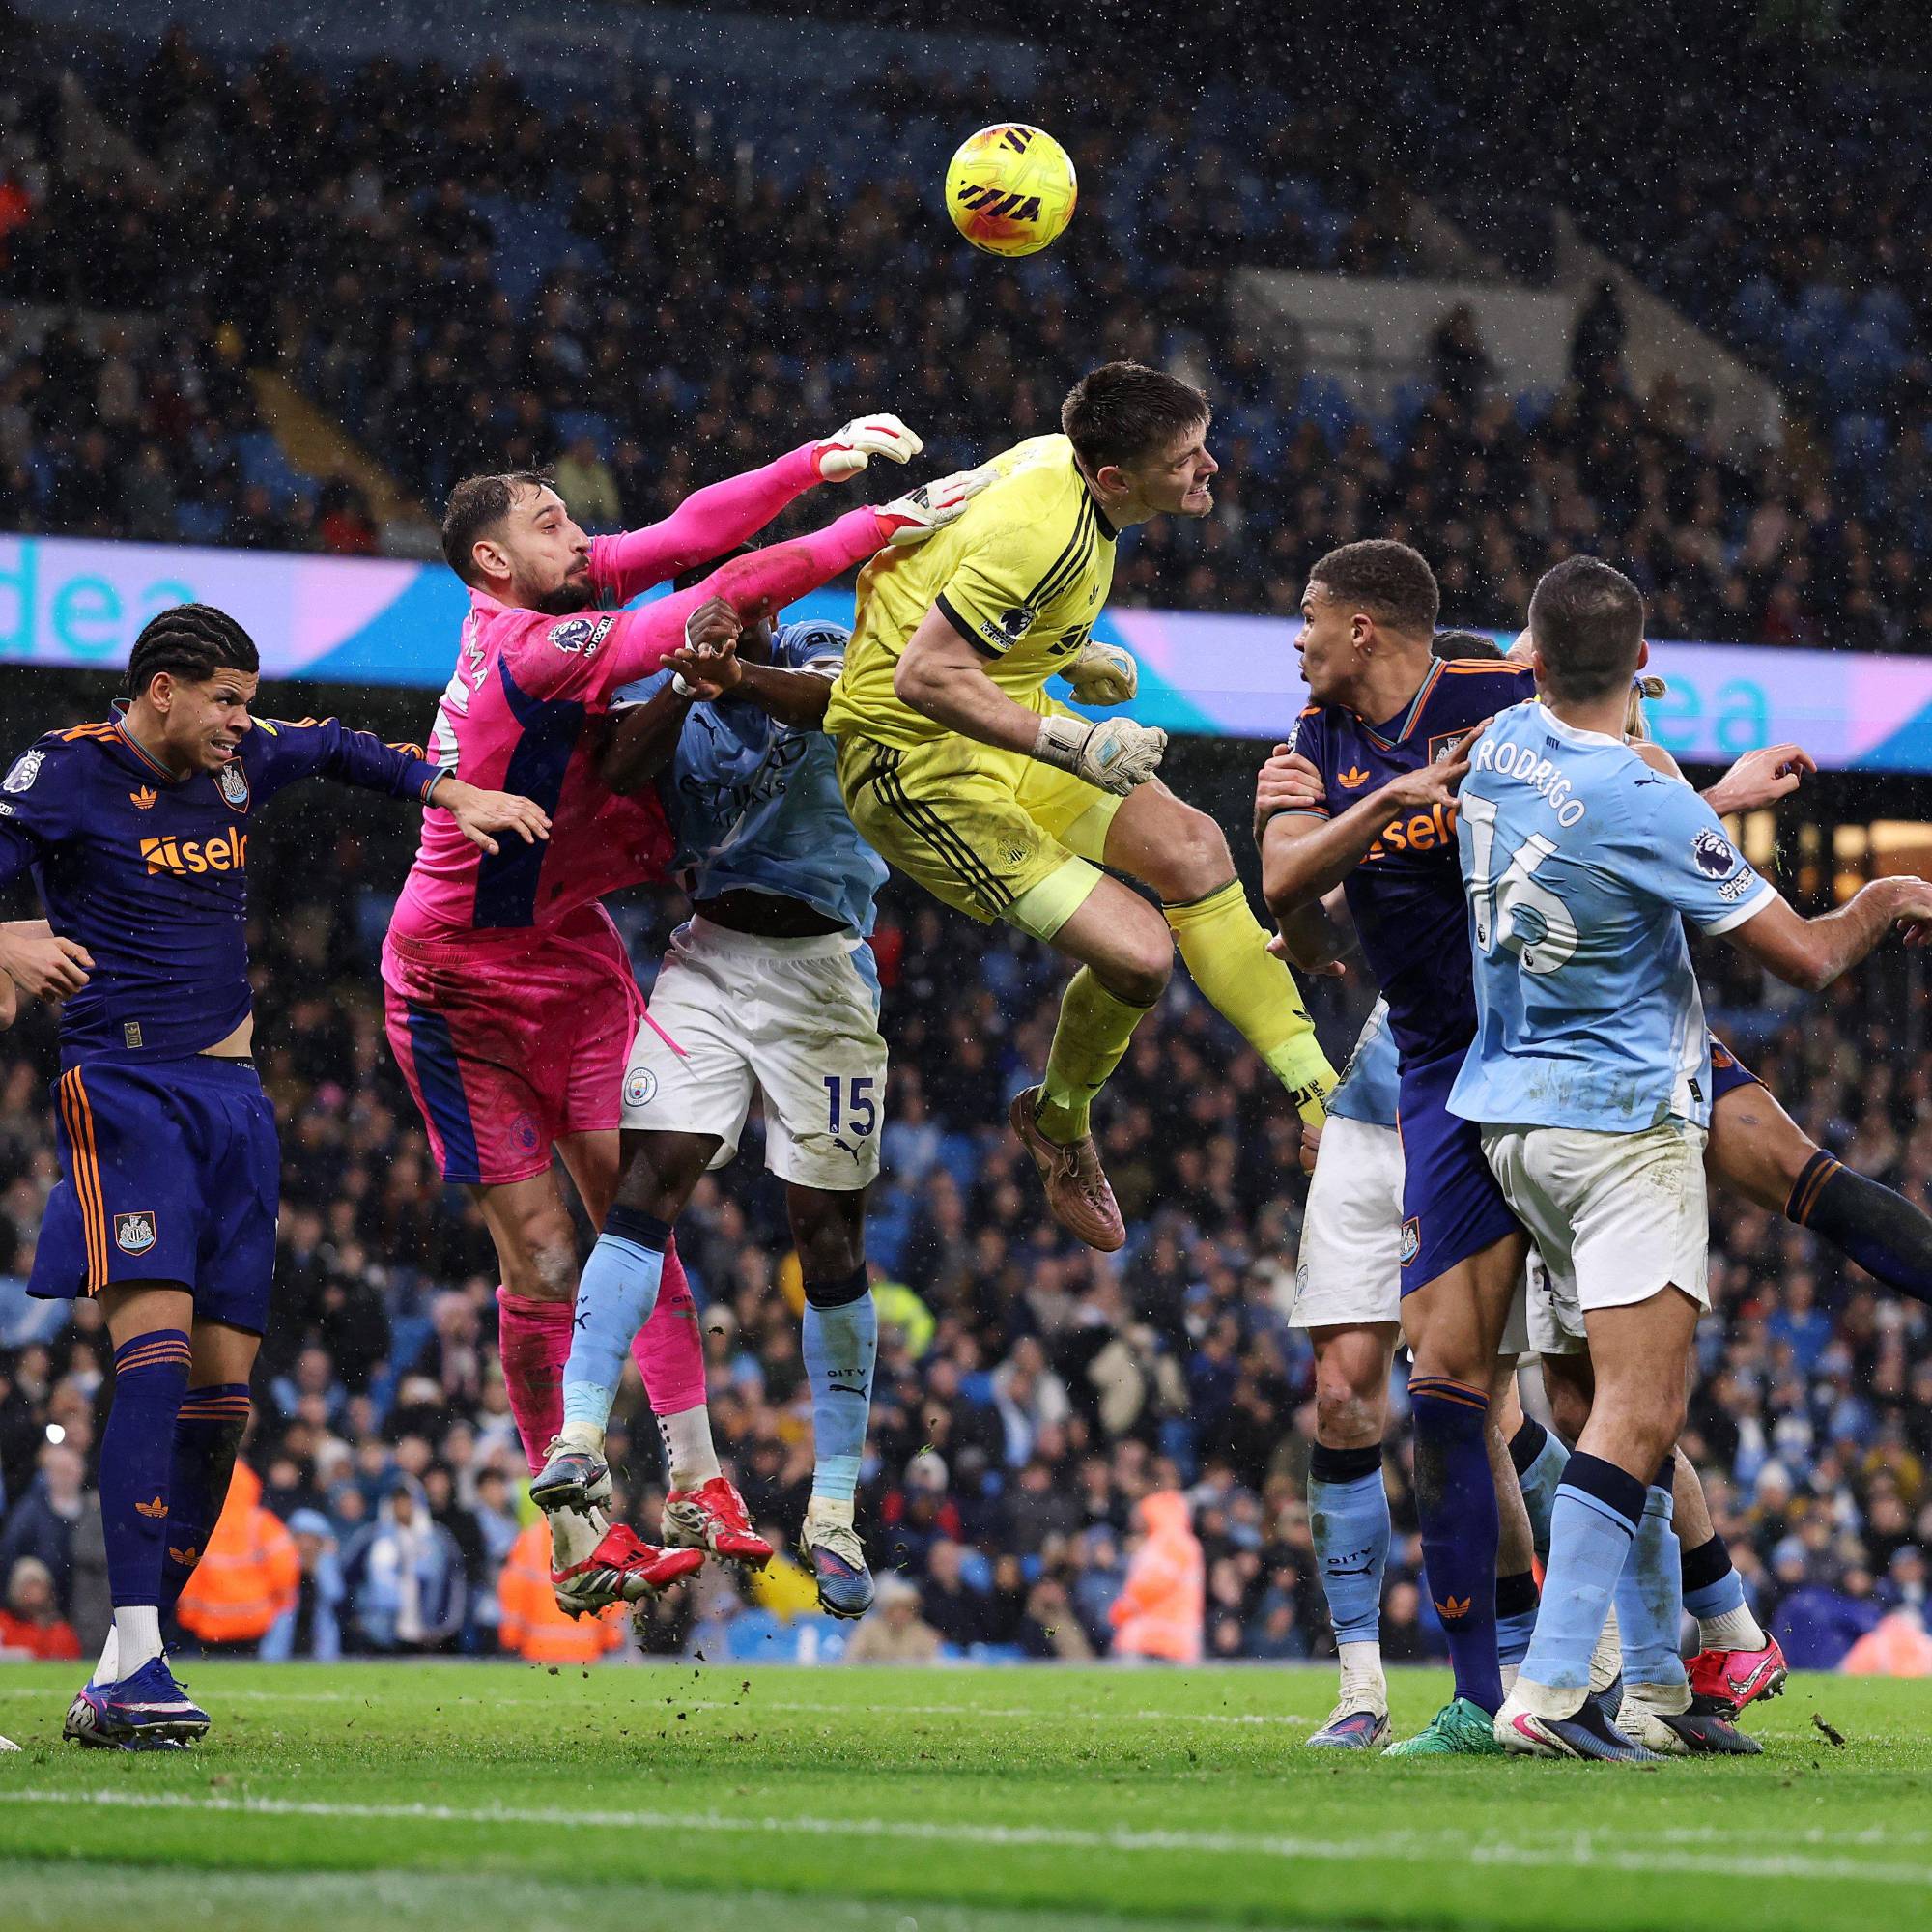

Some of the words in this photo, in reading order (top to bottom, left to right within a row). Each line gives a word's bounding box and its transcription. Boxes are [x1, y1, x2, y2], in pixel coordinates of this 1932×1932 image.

[583, 642, 597, 658] No
[592, 618, 610, 644] room
[1546, 734, 1561, 751] CITY
[1476, 738, 1586, 829] RODRIGO
[1461, 789, 1579, 975] 16
[1718, 883, 1734, 898] No
[823, 1075, 875, 1138] 15
[827, 1368, 866, 1378] CITY
[1327, 1547, 1372, 1564] CITY
